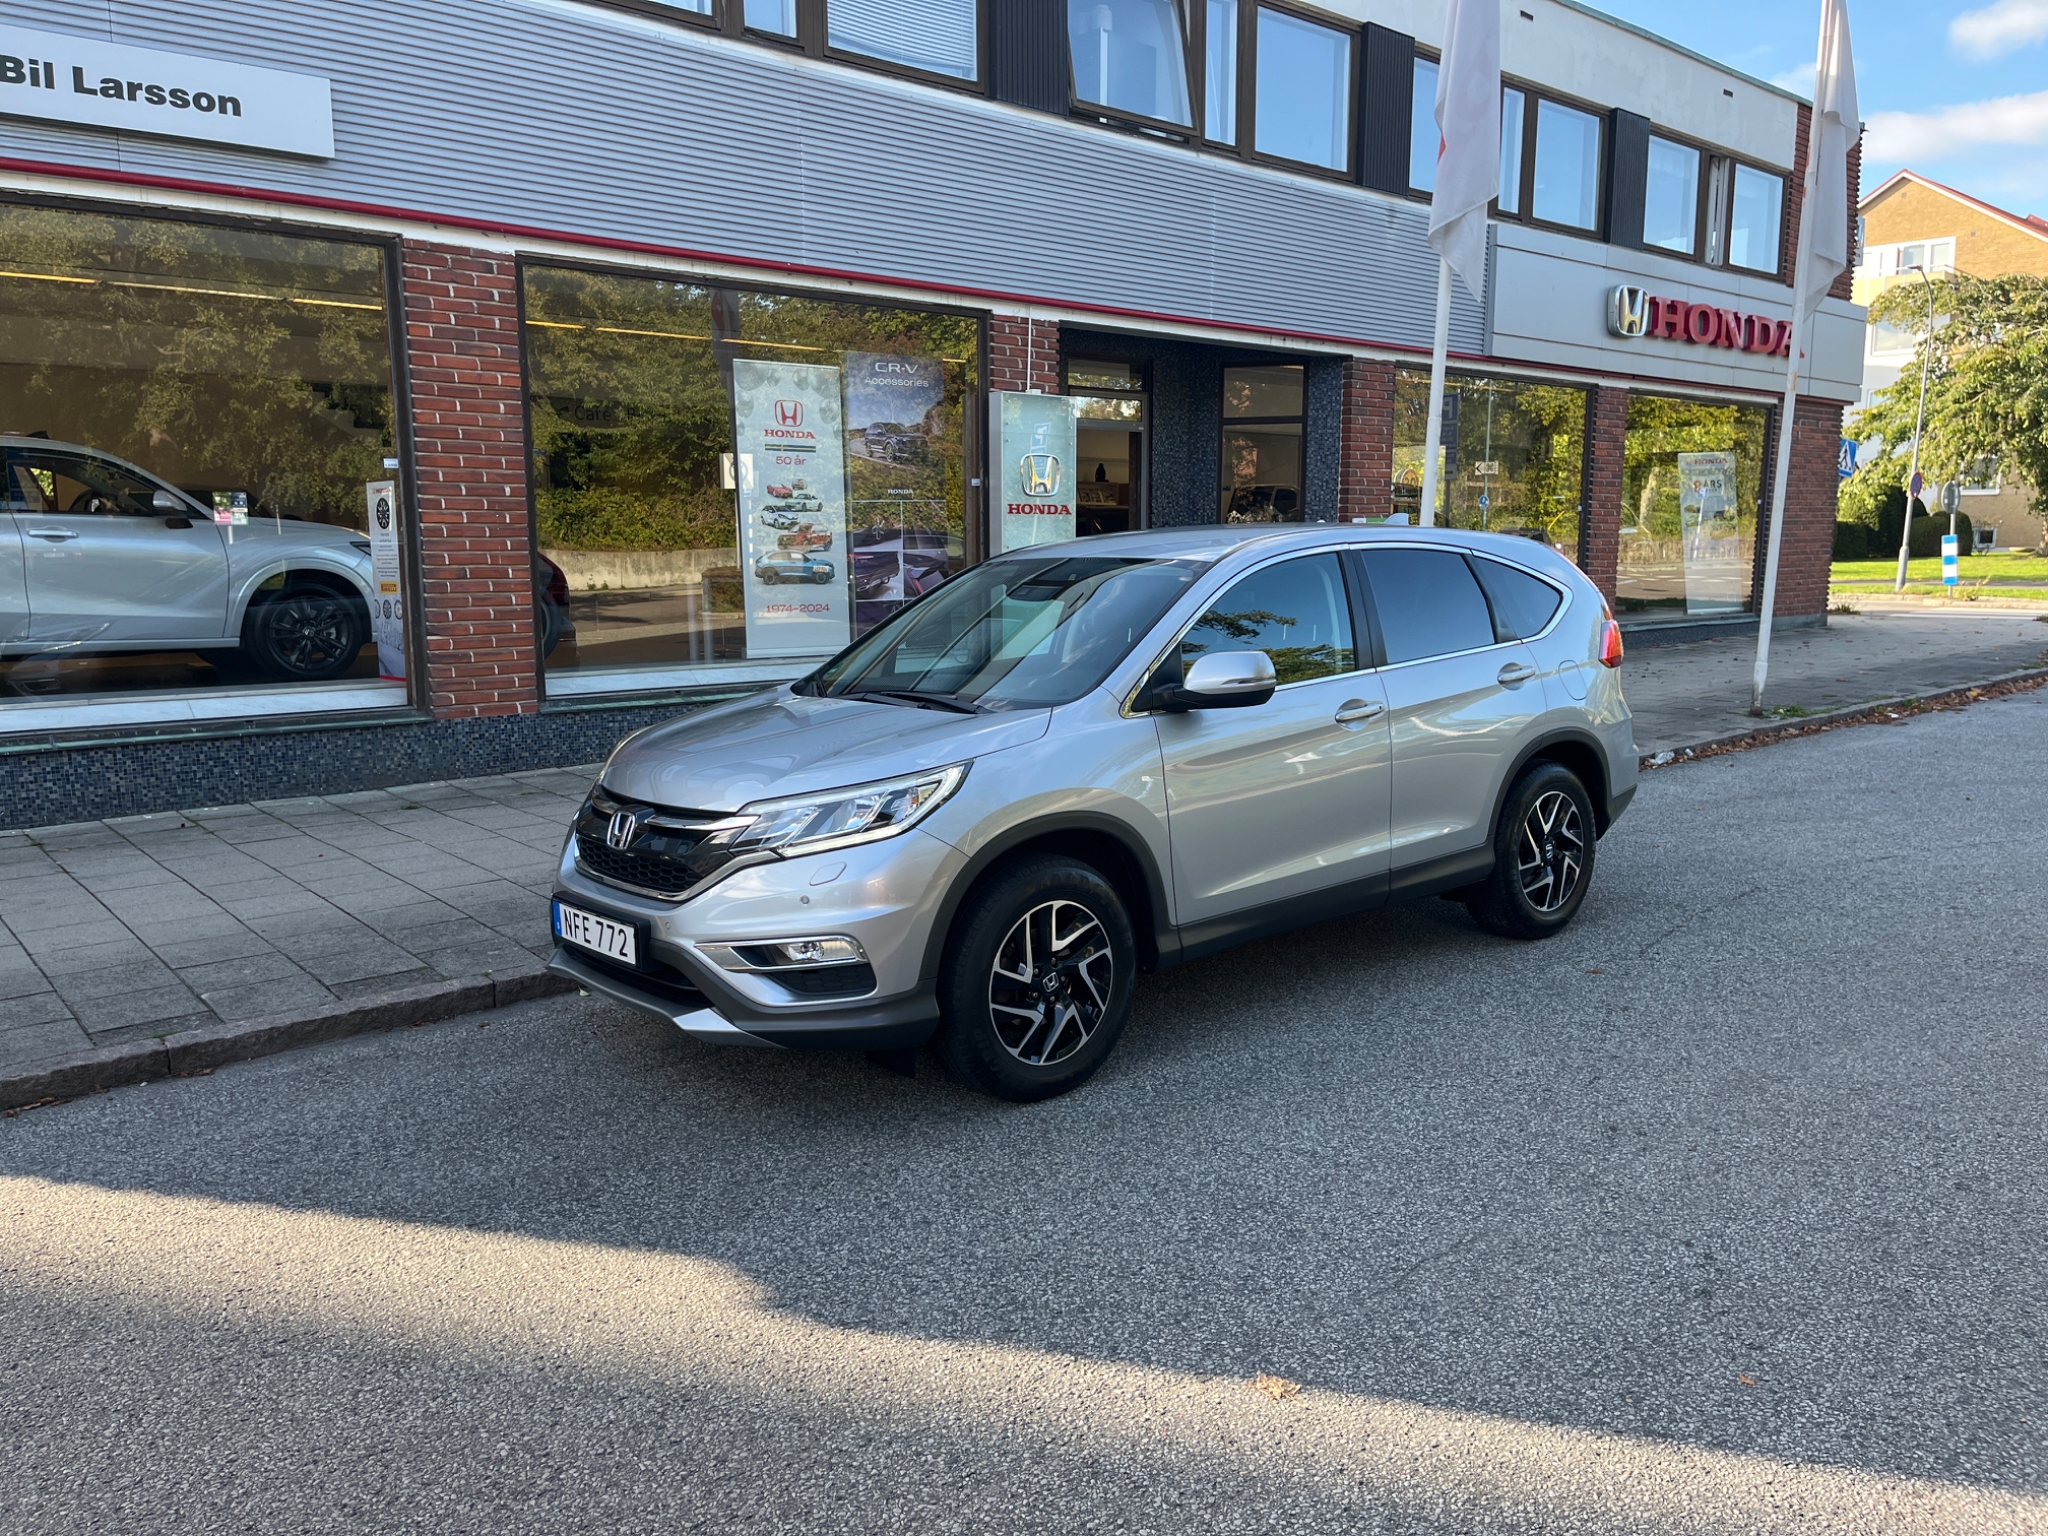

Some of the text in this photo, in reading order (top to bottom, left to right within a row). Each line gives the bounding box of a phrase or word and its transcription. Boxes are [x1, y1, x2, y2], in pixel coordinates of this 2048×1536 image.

[0, 54, 242, 118] Bil Larsson
[875, 362, 918, 374] CR-V
[865, 377, 929, 388] Accessories
[764, 429, 816, 440] HONDA
[775, 455, 807, 466] 50 år
[1007, 503, 1072, 515] HONDA
[563, 908, 628, 958] NFE 772
